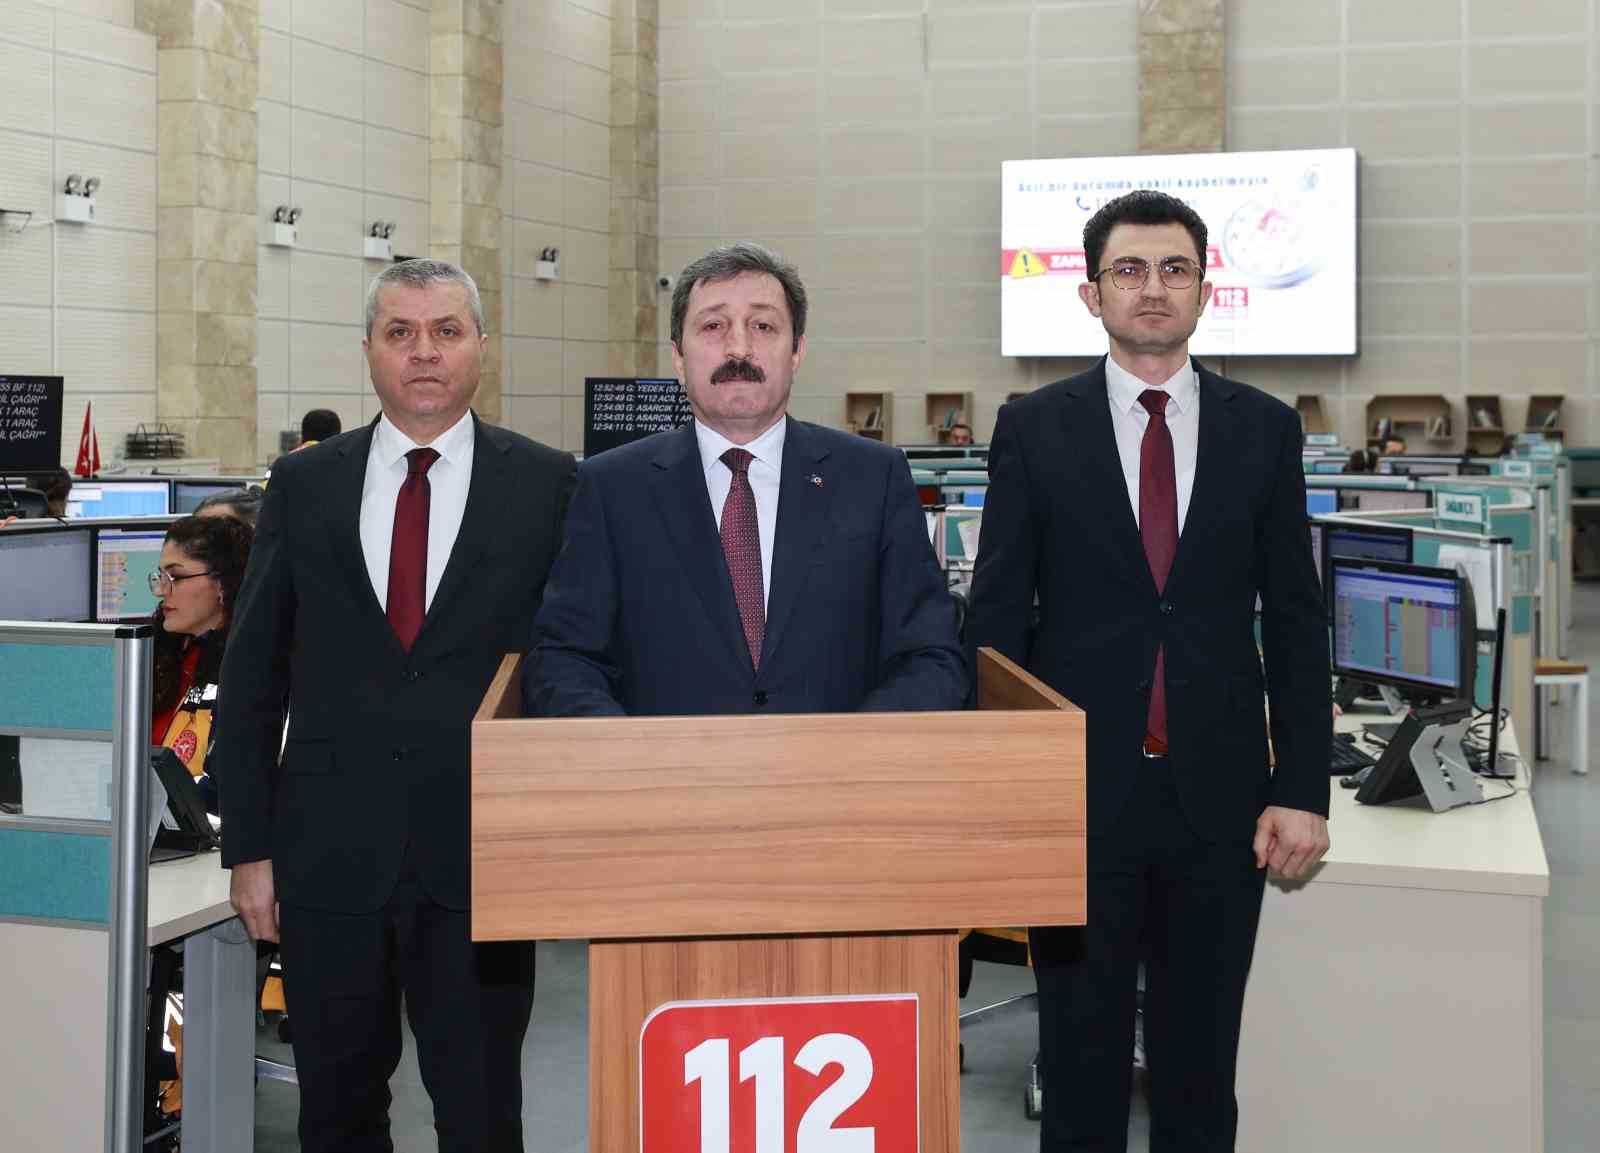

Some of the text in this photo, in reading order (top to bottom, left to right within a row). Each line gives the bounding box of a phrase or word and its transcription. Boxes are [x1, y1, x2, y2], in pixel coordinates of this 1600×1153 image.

[1217, 286, 1247, 307] 112
[637, 384, 664, 392] YEDEK
[636, 404, 672, 412] ASARCIK
[635, 413, 672, 422] ASARCIK
[684, 1032, 876, 1153] 112
